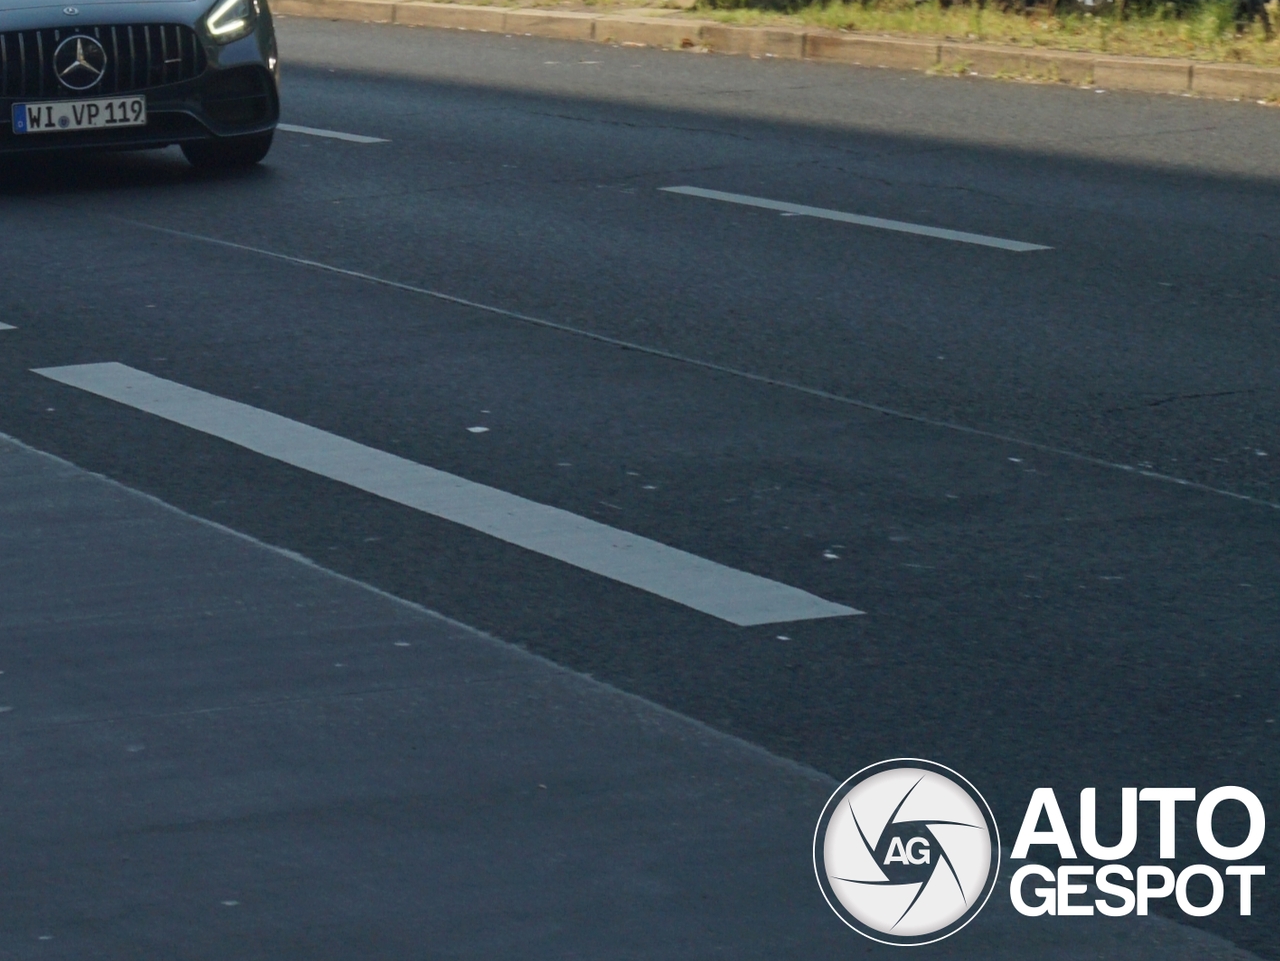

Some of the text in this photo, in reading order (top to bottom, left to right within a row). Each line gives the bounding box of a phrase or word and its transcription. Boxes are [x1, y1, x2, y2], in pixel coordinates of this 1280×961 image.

[27, 105, 56, 129] WI
[72, 103, 99, 126] VP
[105, 100, 143, 124] 119
